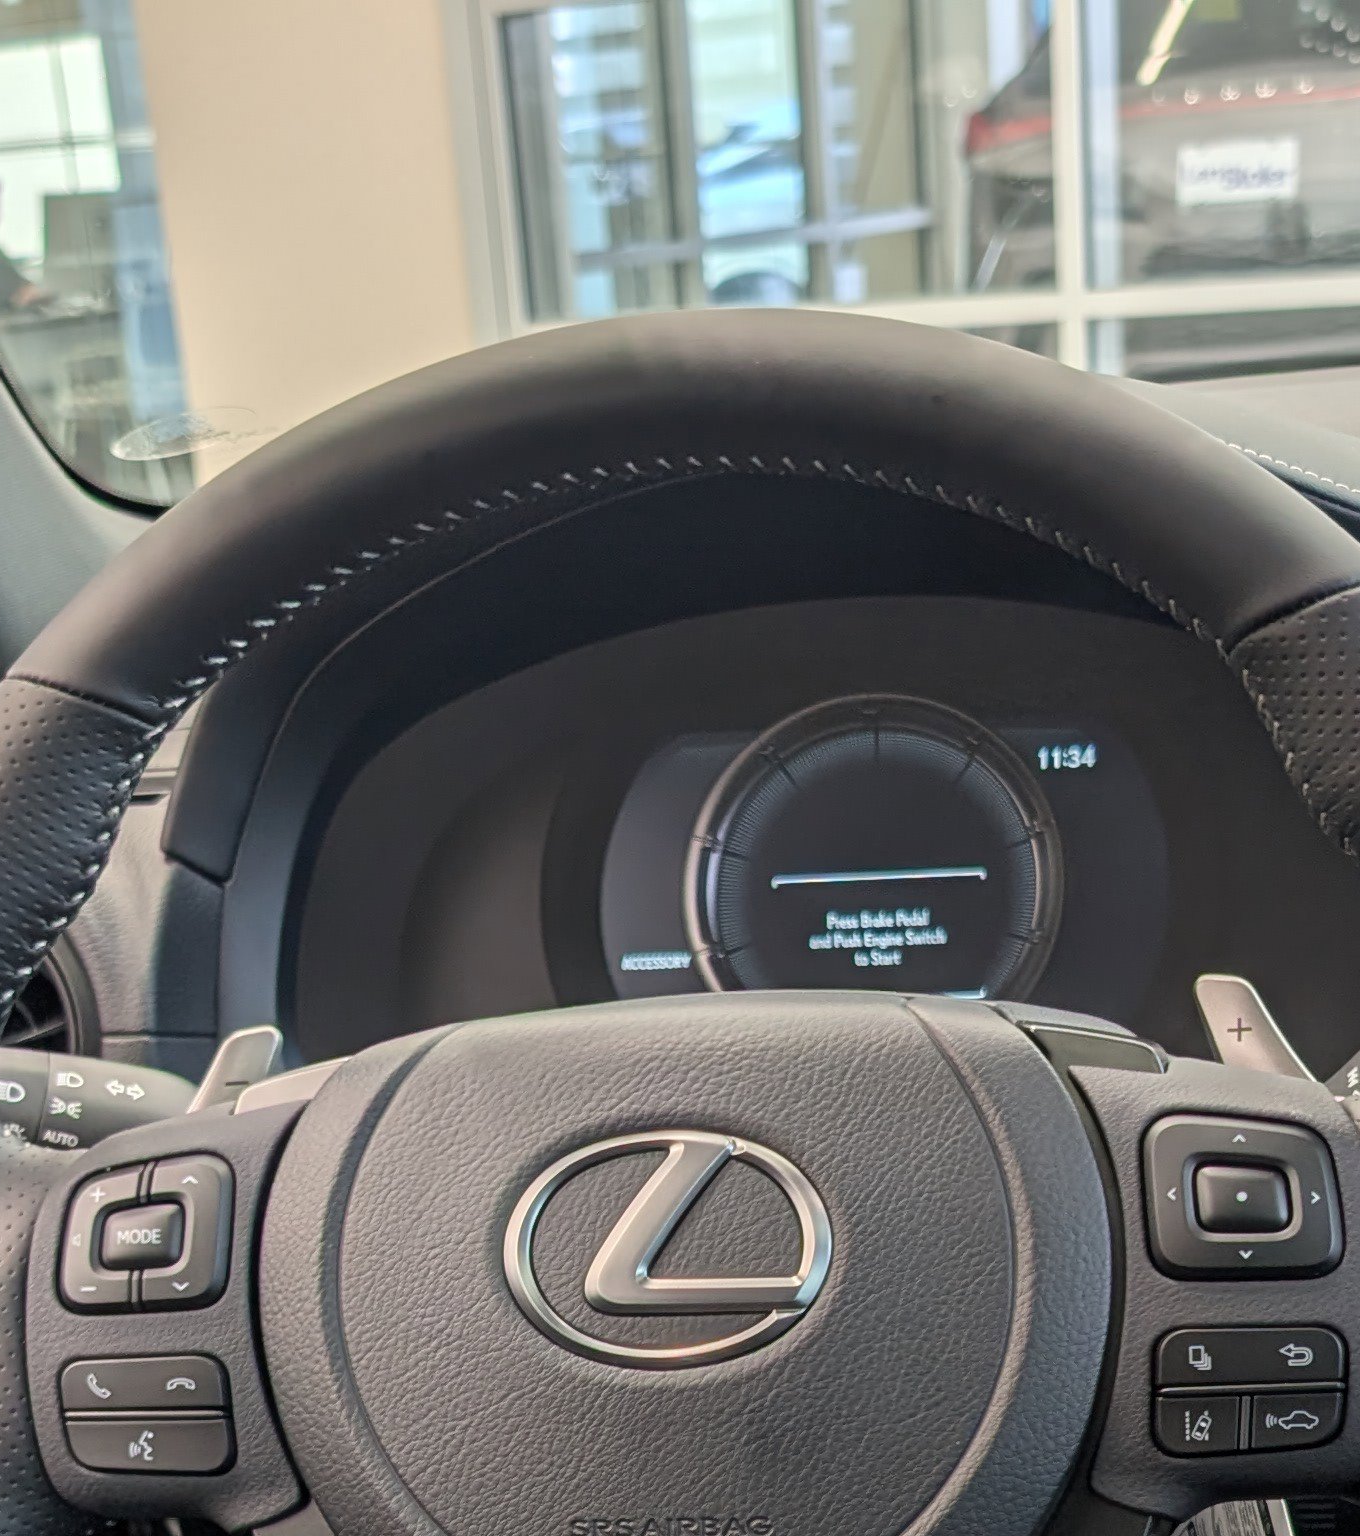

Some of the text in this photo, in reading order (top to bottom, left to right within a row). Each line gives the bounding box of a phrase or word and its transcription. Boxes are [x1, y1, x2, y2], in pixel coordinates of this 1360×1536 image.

[1036, 744, 1097, 770] 11:34
[826, 909, 860, 930] Press
[860, 908, 894, 928] Brake
[809, 924, 948, 949] and Push Engine Switch
[870, 948, 903, 967] Start
[42, 1129, 80, 1148] AUTO
[116, 1228, 162, 1246] MODE
